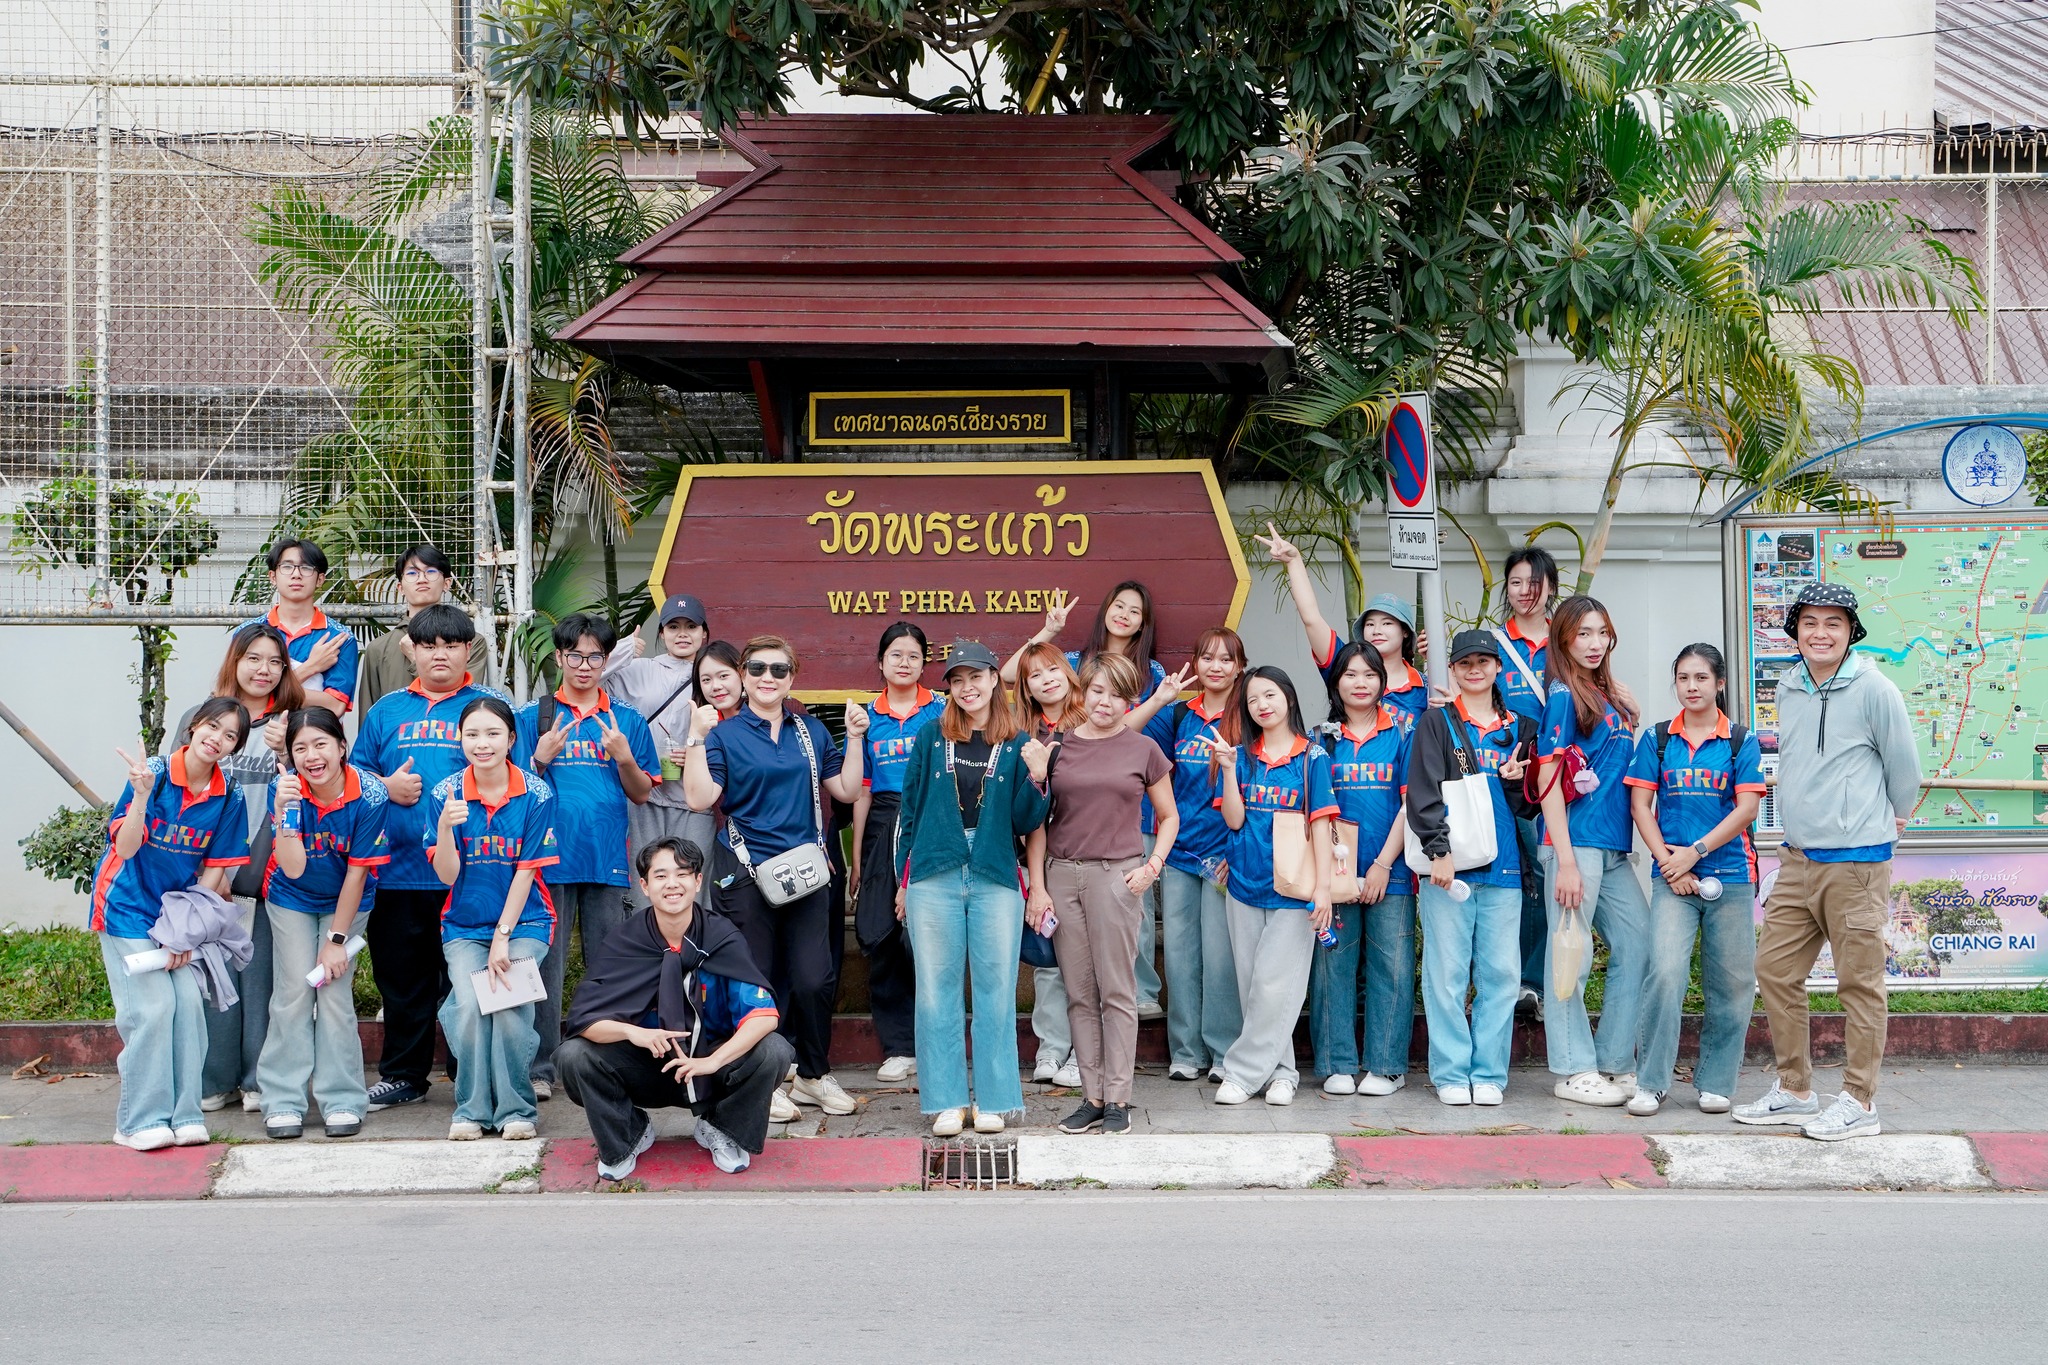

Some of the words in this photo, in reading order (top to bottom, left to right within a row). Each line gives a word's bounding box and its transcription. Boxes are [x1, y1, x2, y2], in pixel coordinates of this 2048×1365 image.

[834, 405, 1047, 432] เทศบาลนครเชียงราย
[806, 484, 1090, 556] วัดพระแก้ว
[1399, 524, 1427, 544] ห้ามจอด
[827, 591, 890, 614] WAT
[900, 590, 976, 613] PHRA
[398, 719, 461, 741] CRRU
[1331, 763, 1393, 782] CRRU
[1663, 768, 1729, 790] CRRU
[150, 818, 213, 849] CRRU
[1949, 865, 2023, 885] ยินดีต้อนรับสู่
[1924, 889, 1975, 907] จังหวัด
[1980, 887, 2038, 907] เชียงราย
[1960, 918, 1998, 926] WELCOME
[1931, 935, 2003, 950] CHIANG
[2008, 935, 2035, 949] RAI
